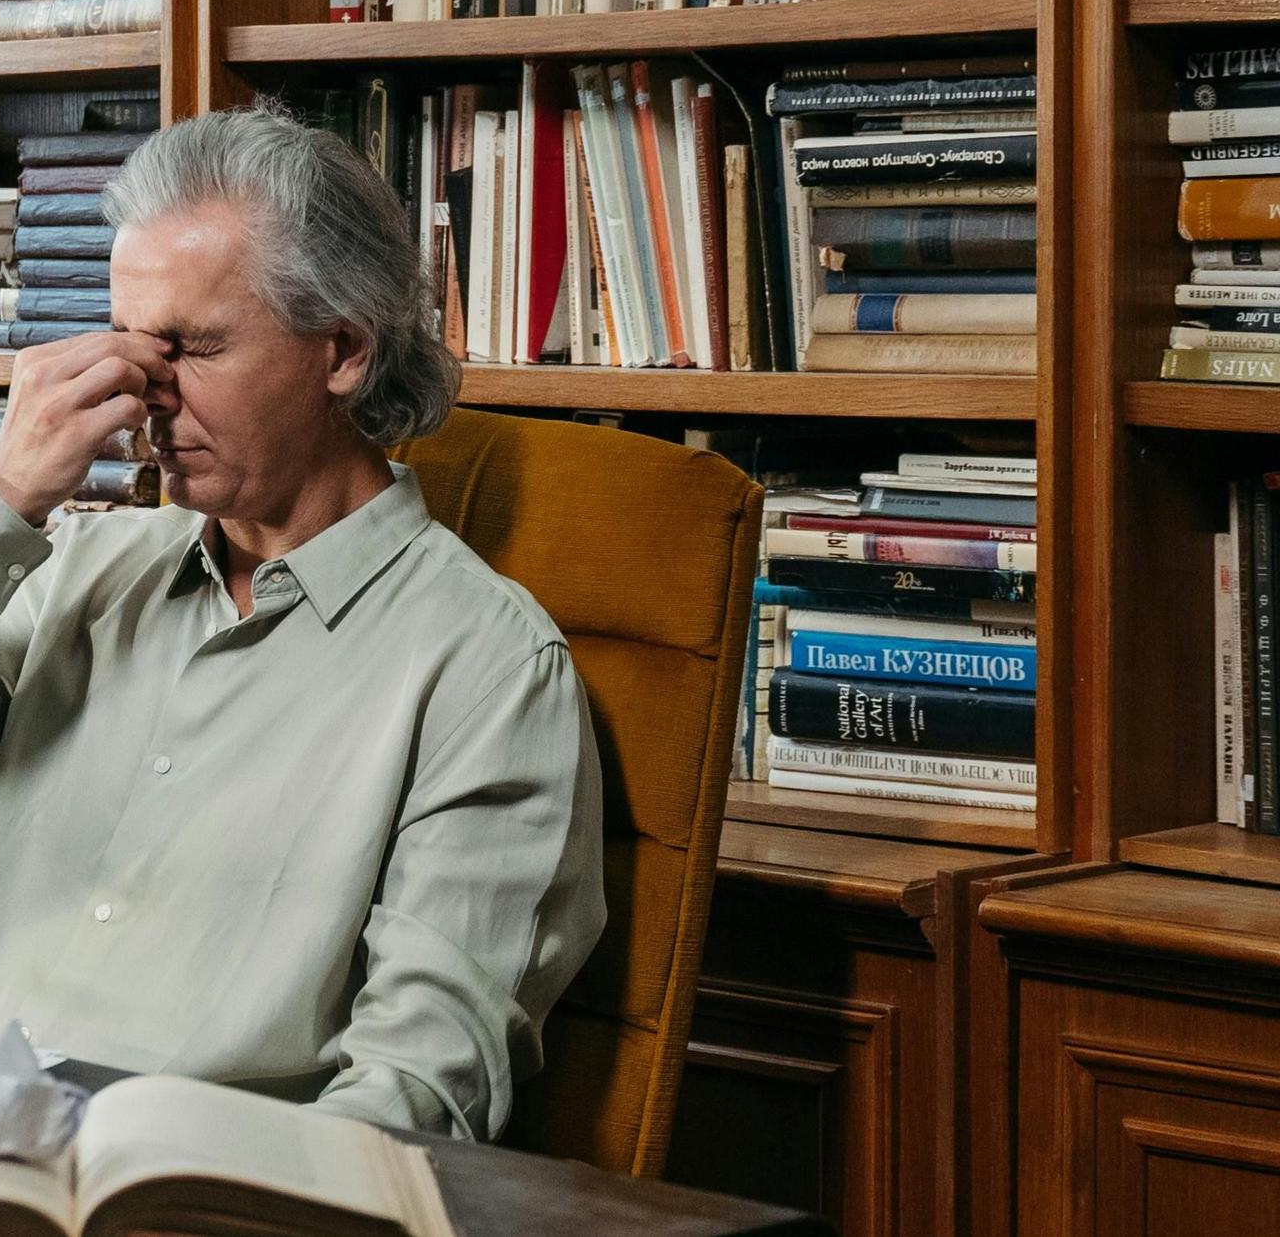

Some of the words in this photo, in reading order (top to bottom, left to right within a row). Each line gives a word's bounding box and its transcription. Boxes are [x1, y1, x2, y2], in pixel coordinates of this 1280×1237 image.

[800, 158, 831, 172] мира
[833, 158, 869, 170] нового
[871, 151, 936, 170] Скульптура
[1188, 289, 1232, 301] MEISTER
[1233, 290, 1259, 302] IHRE
[1236, 310, 1270, 327] Loire
[1210, 358, 1275, 379] NAÏFS
[806, 645, 877, 673] Павел
[882, 649, 1026, 684] КУЗНЕЦОВ
[838, 683, 851, 741] National
[855, 688, 870, 741] Gallery
[872, 696, 884, 718] Art
[874, 719, 884, 739] of
